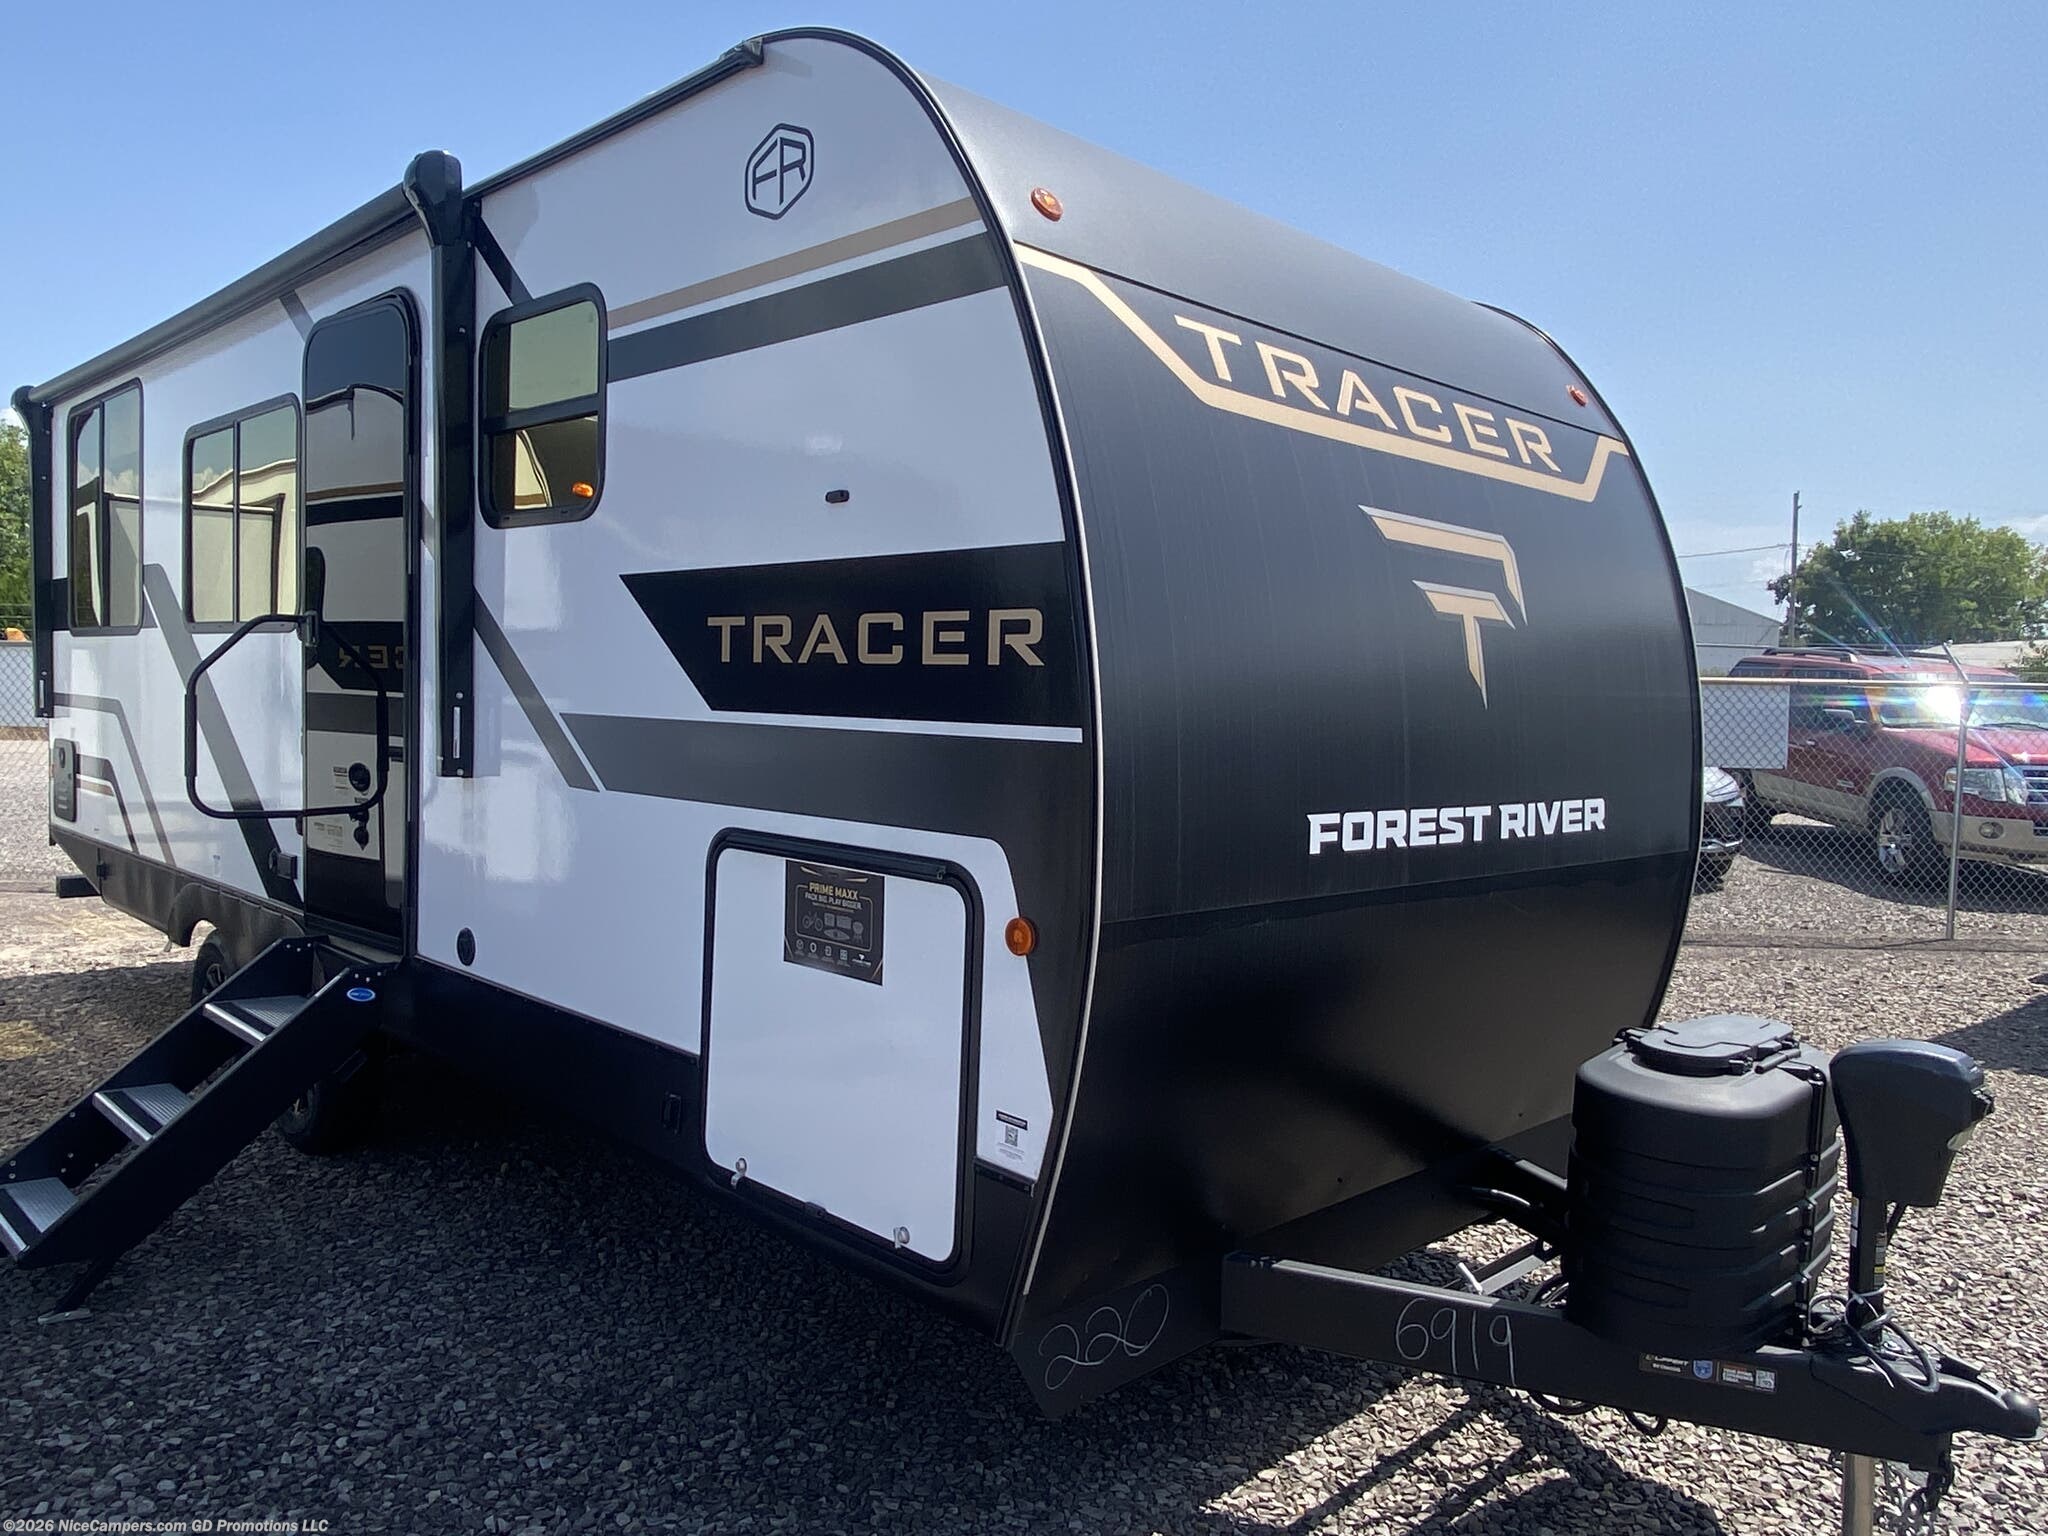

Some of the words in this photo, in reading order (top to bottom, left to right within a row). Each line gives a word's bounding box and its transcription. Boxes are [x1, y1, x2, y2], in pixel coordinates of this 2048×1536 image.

[1174, 314, 1563, 473] TRACER
[706, 608, 1045, 667] TRACER
[1306, 805, 1492, 855] FOREST
[1498, 797, 1606, 840] RIVER
[809, 882, 834, 896] PRIME
[835, 887, 858, 900] MAXX
[1038, 1283, 1170, 1391] 220
[1395, 1297, 1517, 1386] 6919
